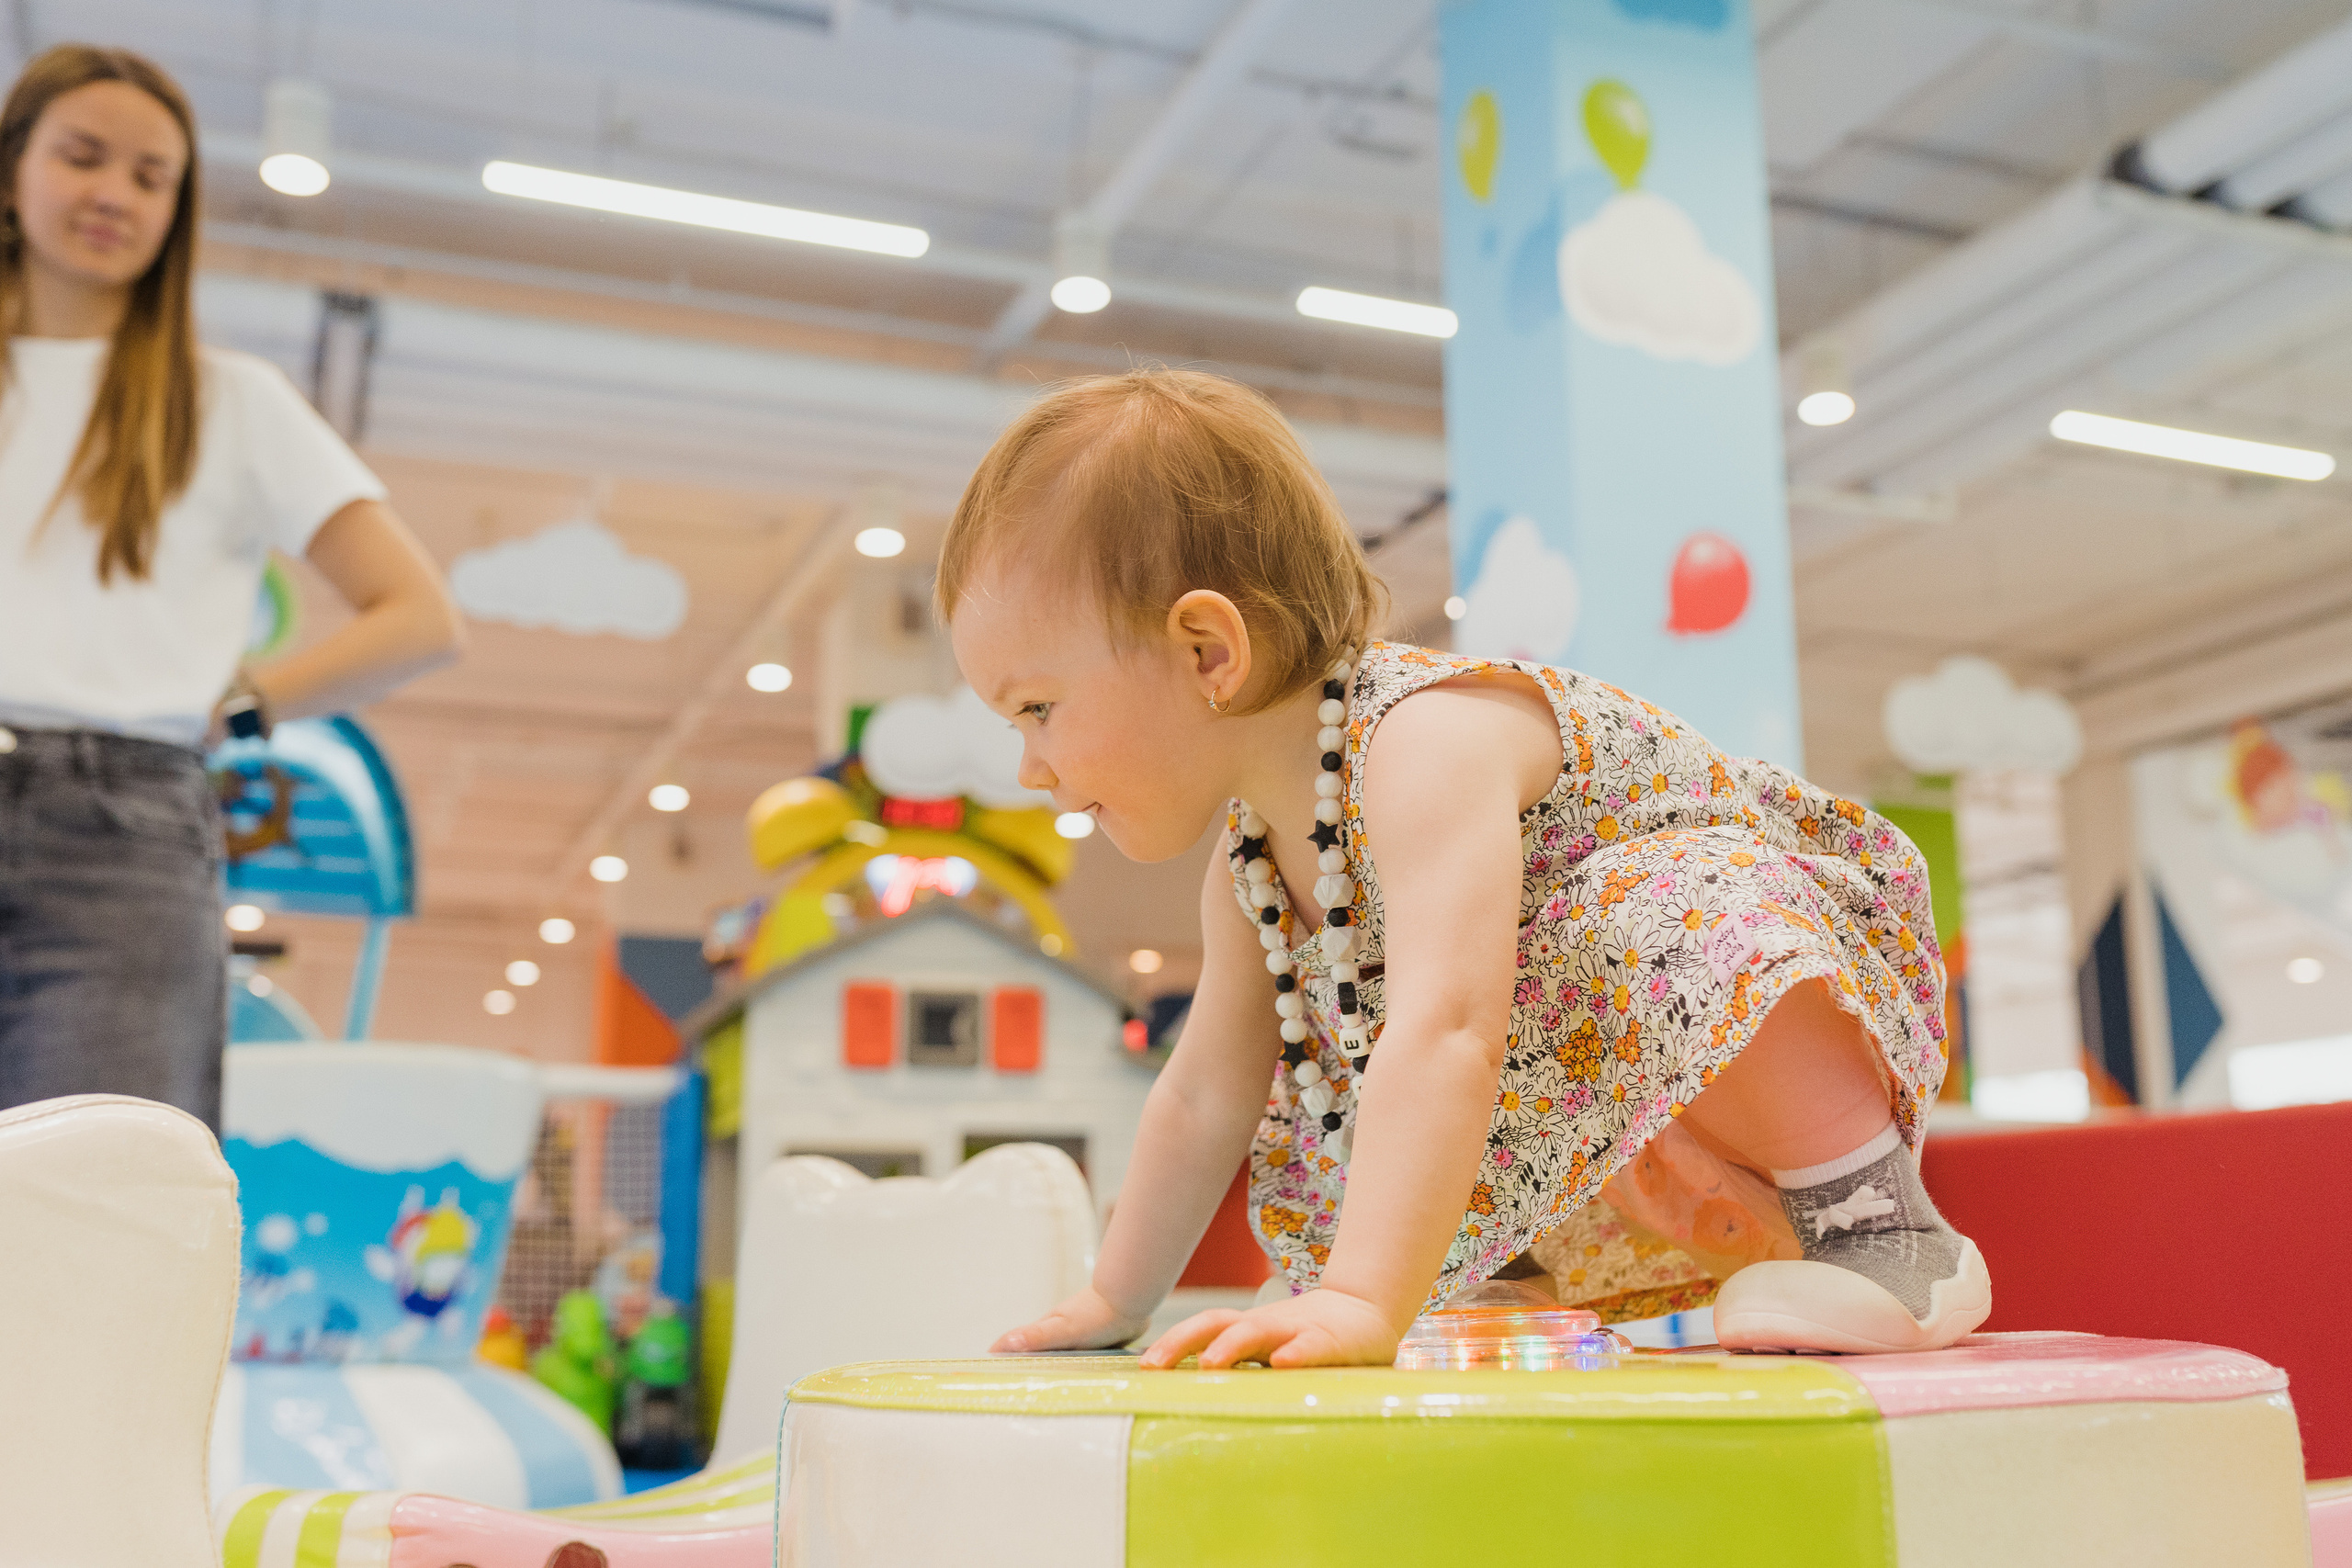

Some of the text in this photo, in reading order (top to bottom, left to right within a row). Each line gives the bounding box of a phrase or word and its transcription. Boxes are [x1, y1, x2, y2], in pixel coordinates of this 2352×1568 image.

[1712, 924, 1737, 950] today
[1721, 942, 1745, 971] yours
[1724, 942, 1732, 953] is
[1344, 1039, 1360, 1050] E
